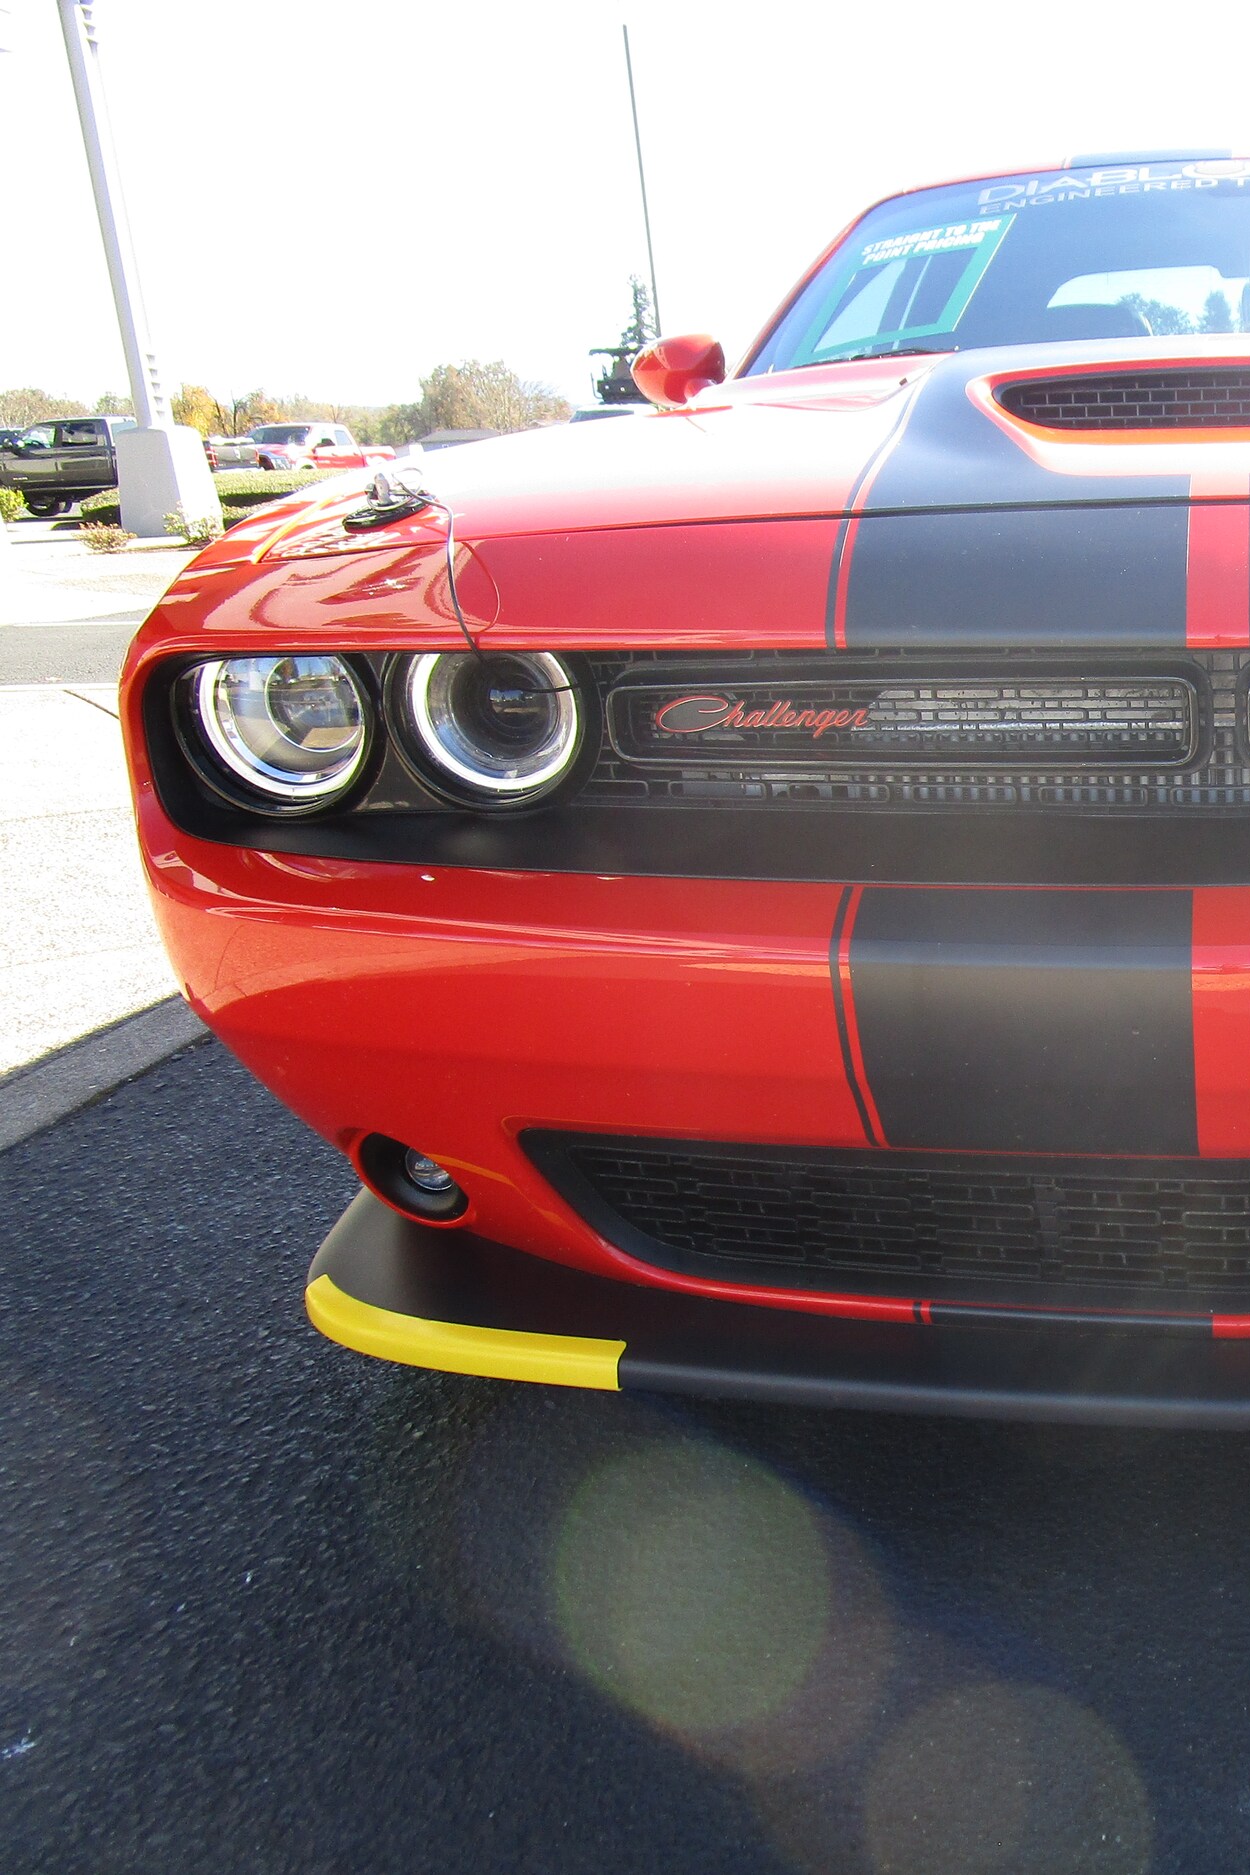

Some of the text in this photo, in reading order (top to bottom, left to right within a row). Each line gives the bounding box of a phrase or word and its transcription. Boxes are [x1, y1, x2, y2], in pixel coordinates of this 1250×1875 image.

[979, 177, 1218, 214] ENGINEERED
[862, 228, 944, 256] STRAIGHT
[945, 224, 968, 236] TO
[862, 232, 985, 265] POINT PRICING
[655, 695, 869, 739] Challenger
